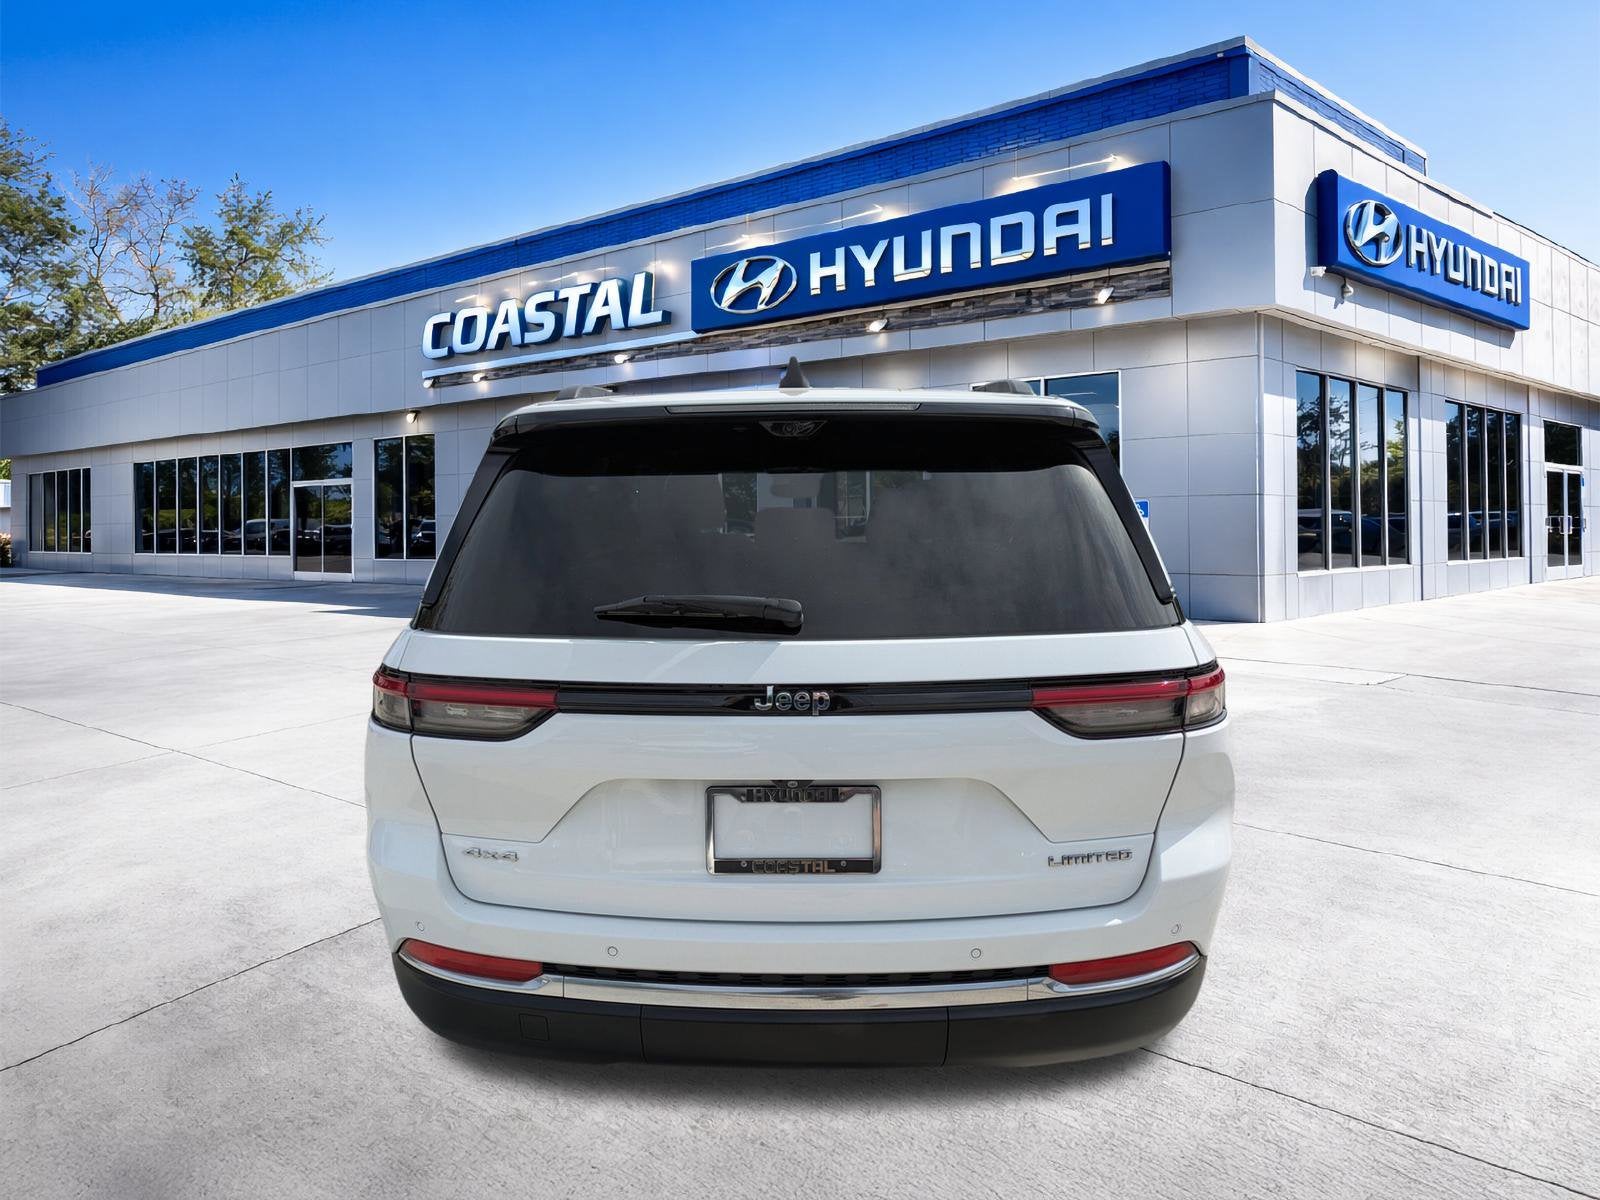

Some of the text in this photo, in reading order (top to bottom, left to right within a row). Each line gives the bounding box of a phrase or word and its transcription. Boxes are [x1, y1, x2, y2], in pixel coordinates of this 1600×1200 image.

[808, 193, 1114, 296] HYUNDAI
[1406, 224, 1522, 306] HYUNDAI
[421, 271, 666, 360] COASTAL
[753, 685, 831, 716] Jeep
[752, 787, 834, 802] HYUNDAI
[1047, 849, 1133, 868] LIMITED
